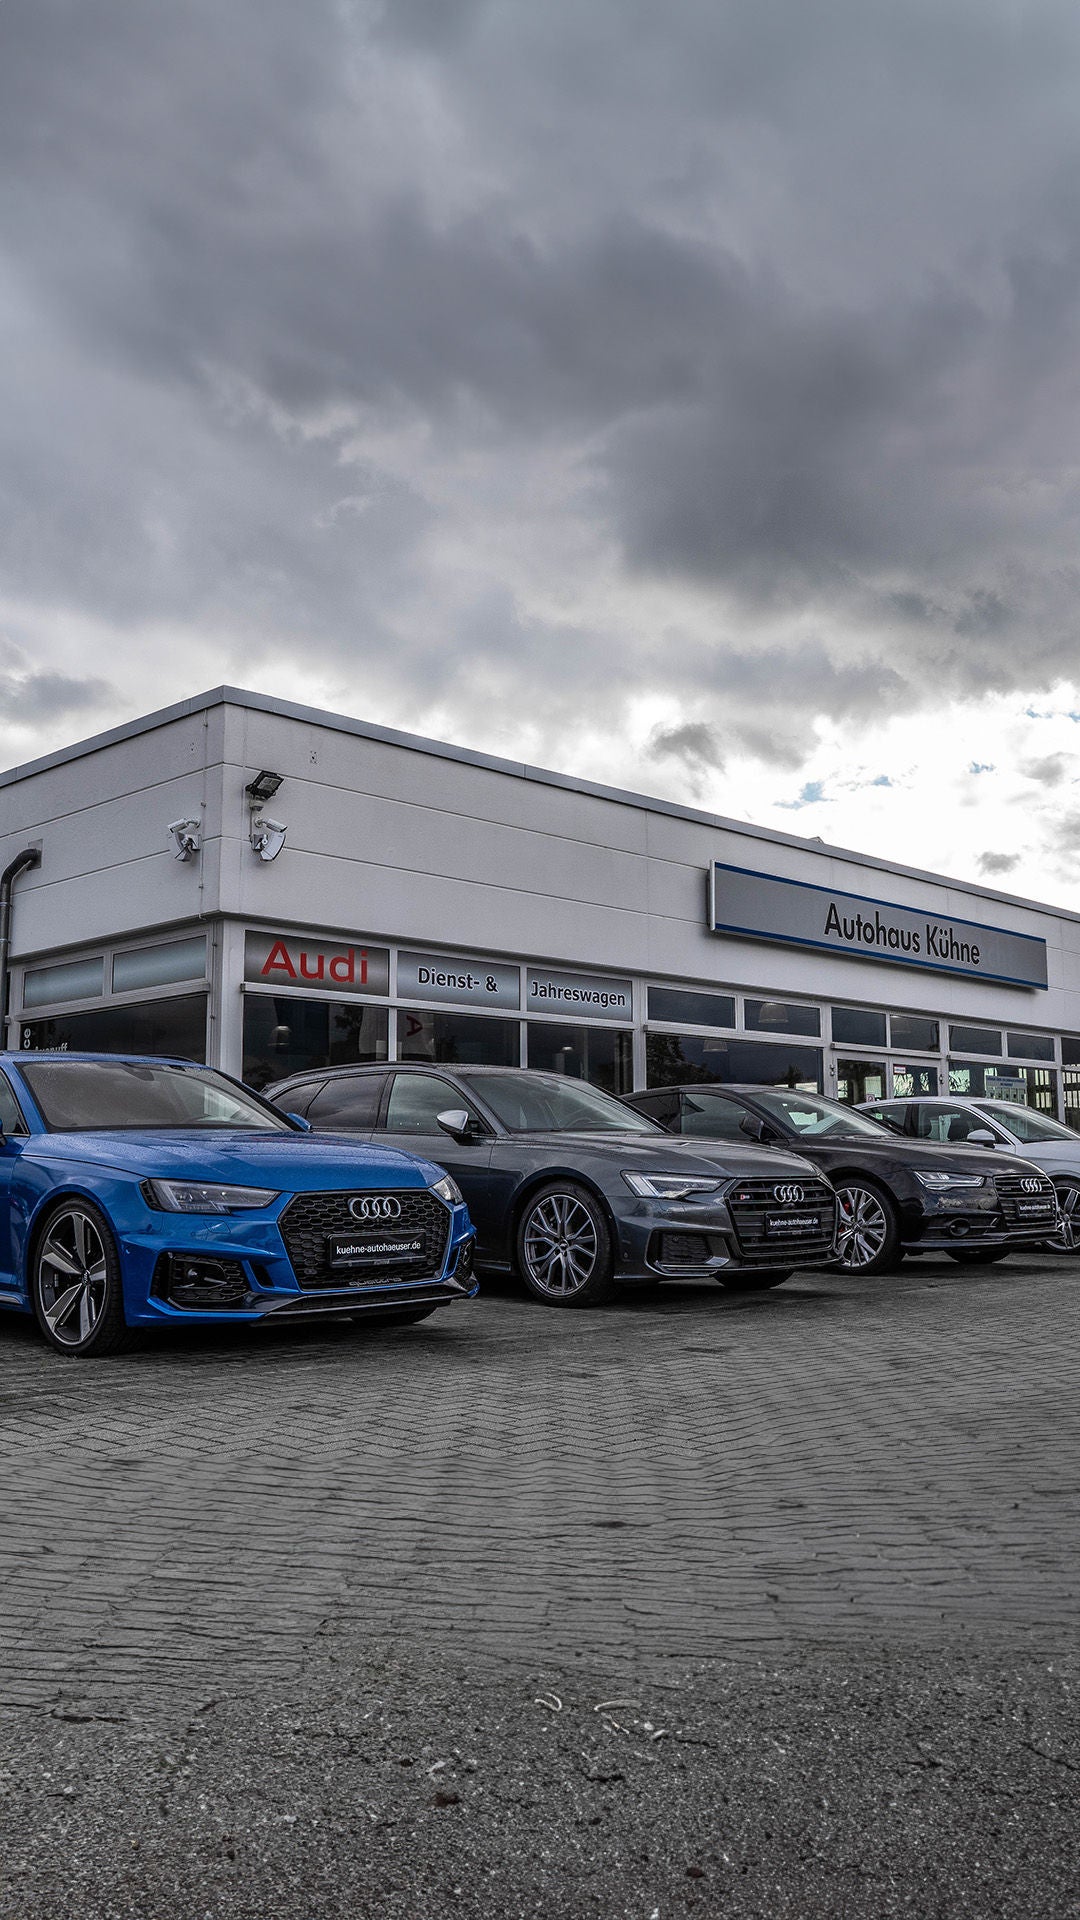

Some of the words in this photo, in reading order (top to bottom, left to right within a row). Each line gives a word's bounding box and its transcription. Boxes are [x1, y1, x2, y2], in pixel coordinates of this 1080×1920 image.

[824, 902, 921, 953] Autohaus
[926, 924, 980, 964] Kühne
[261, 940, 368, 984] Audi
[417, 967, 480, 990] Dienst-
[485, 976, 499, 993] &
[531, 981, 626, 1008] Jahreswagen
[336, 1241, 421, 1255] kuehne-autohaeuser.de
